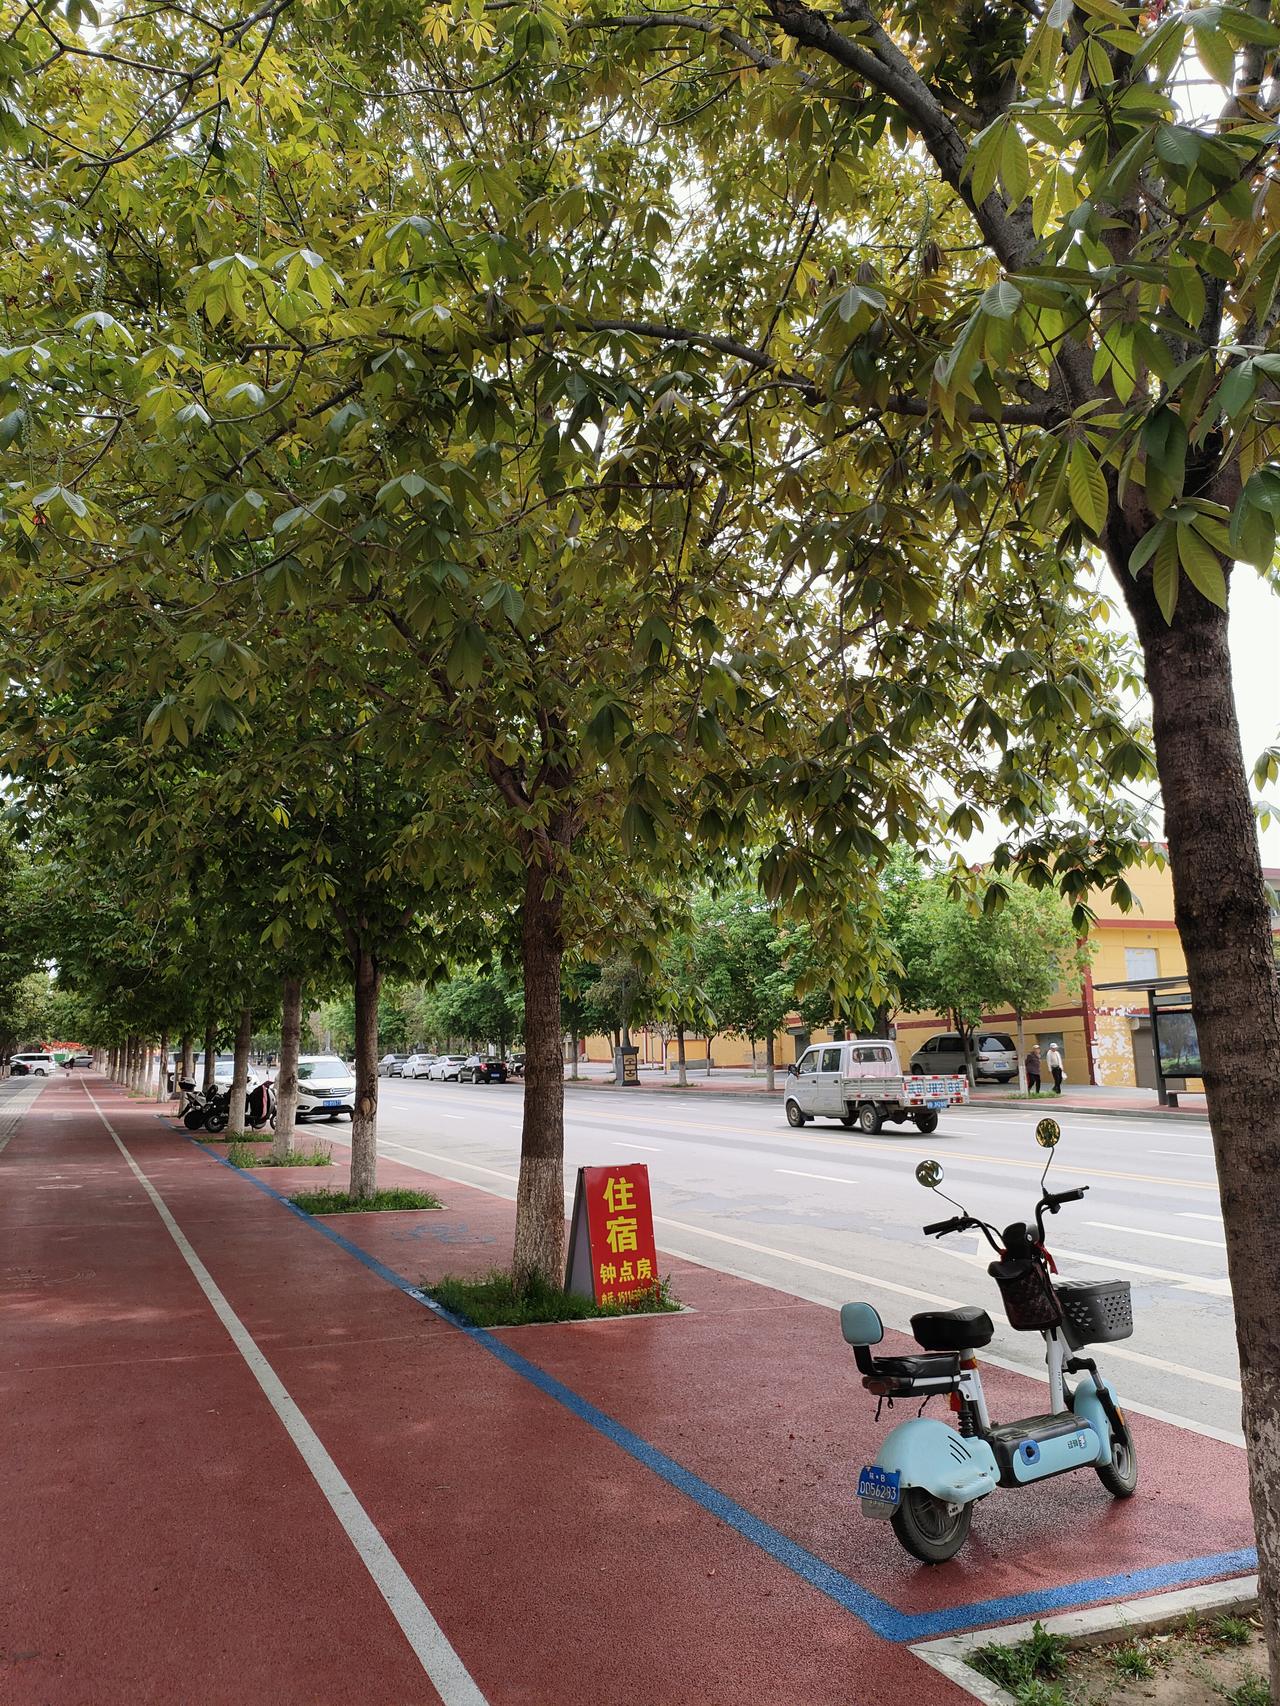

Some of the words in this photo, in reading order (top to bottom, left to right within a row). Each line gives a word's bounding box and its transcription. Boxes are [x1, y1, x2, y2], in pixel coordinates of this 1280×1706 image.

[603, 1177, 638, 1253] 住宿
[600, 1257, 652, 1285] 钟点房
